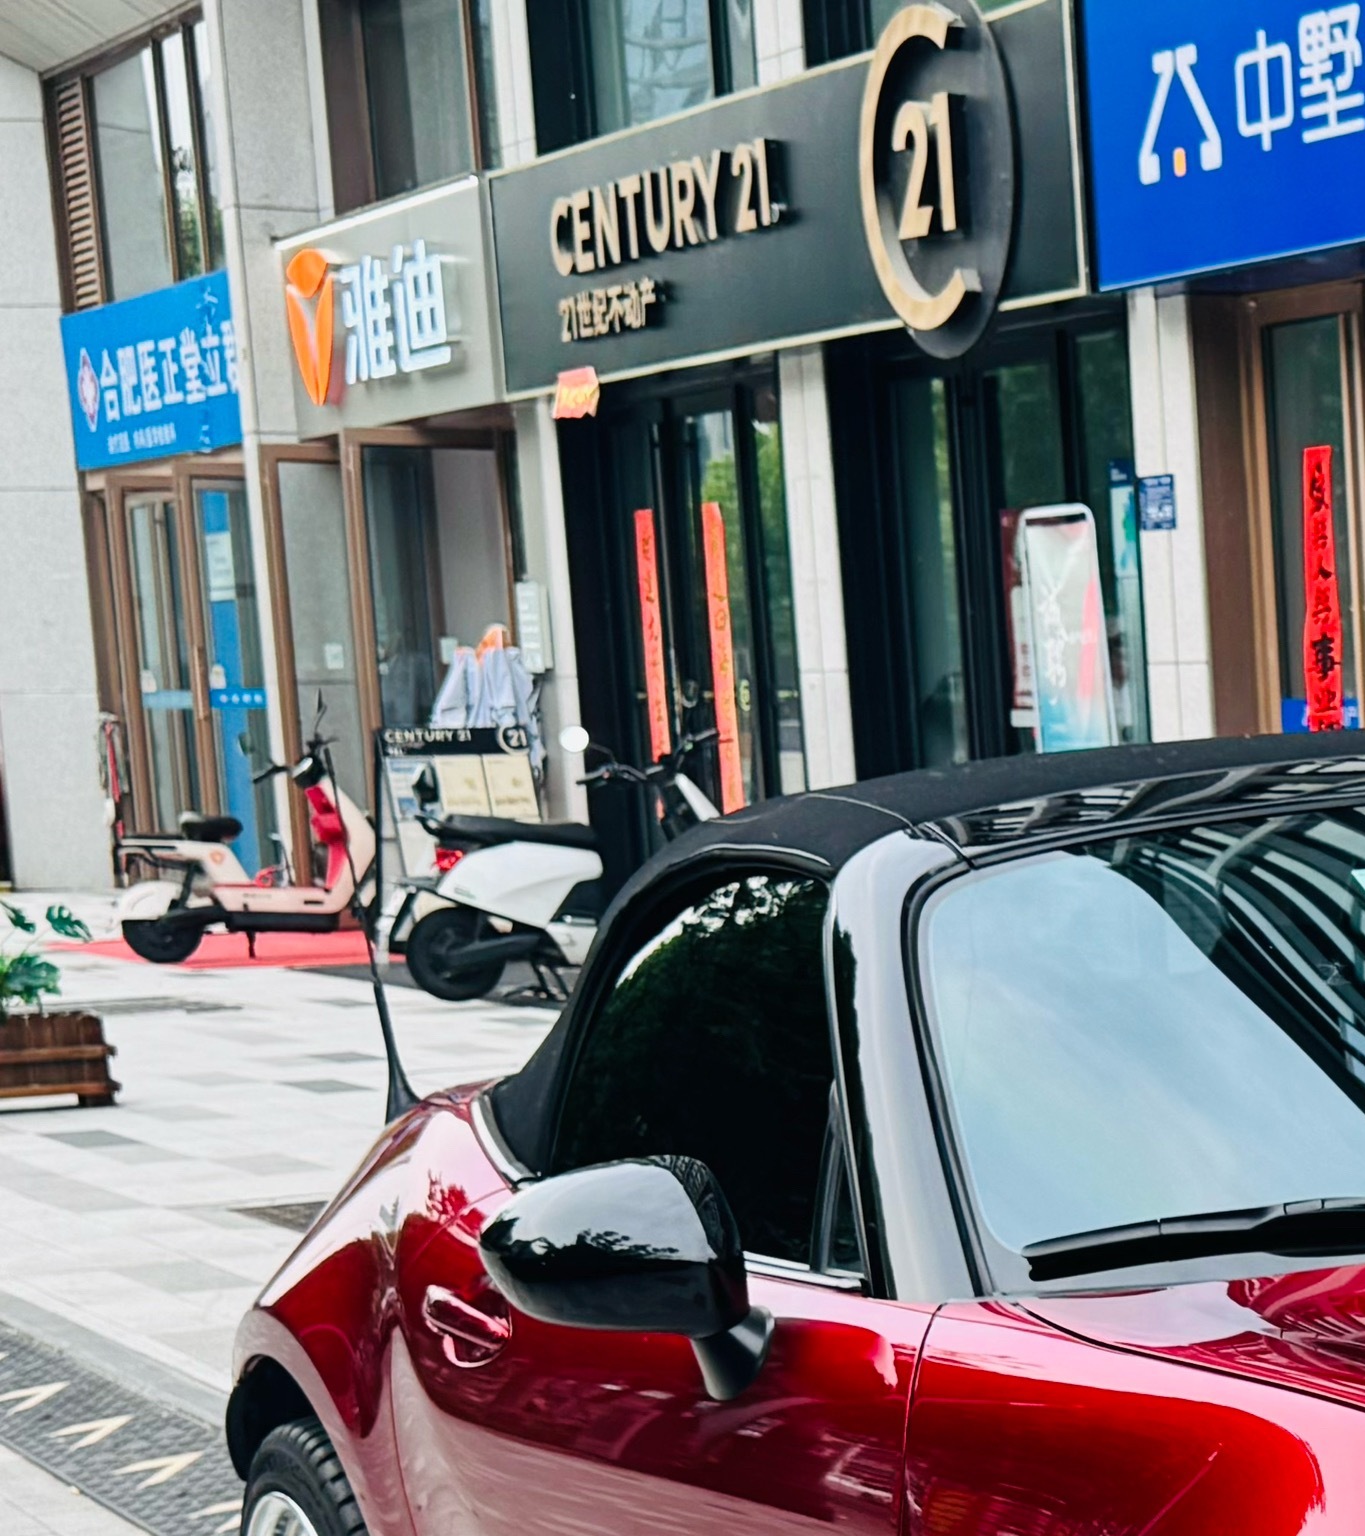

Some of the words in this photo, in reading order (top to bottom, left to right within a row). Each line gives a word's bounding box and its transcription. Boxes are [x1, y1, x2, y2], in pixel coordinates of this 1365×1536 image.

[550, 148, 722, 277] CENTURY
[340, 237, 452, 386] 雅迪
[557, 276, 657, 344] 21世纪不动产
[384, 728, 454, 744] CENTURY
